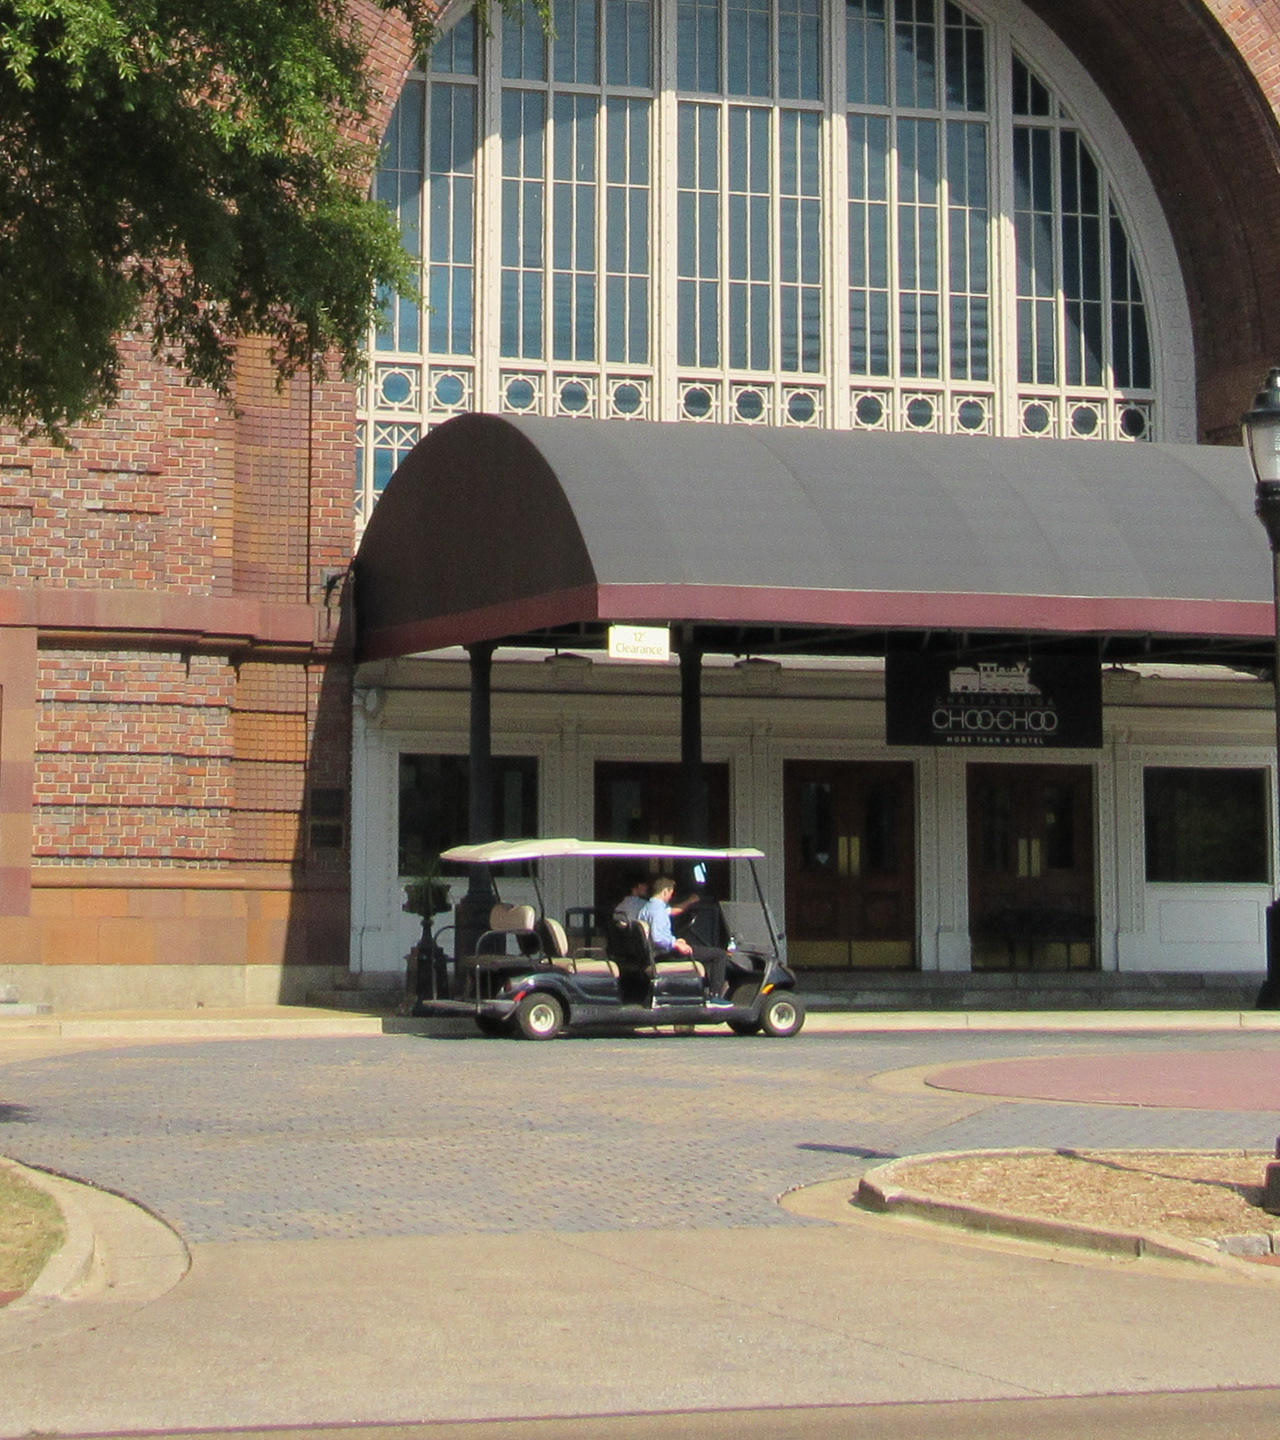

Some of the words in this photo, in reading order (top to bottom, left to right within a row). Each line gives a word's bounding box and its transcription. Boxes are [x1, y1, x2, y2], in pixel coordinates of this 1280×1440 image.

[633, 631, 646, 642] 12'
[615, 642, 663, 655] Clearance
[935, 695, 1054, 706] CHATTANOOGA
[932, 709, 1058, 731] CHOO-CHOO
[1015, 736, 1044, 744] HOTEL
